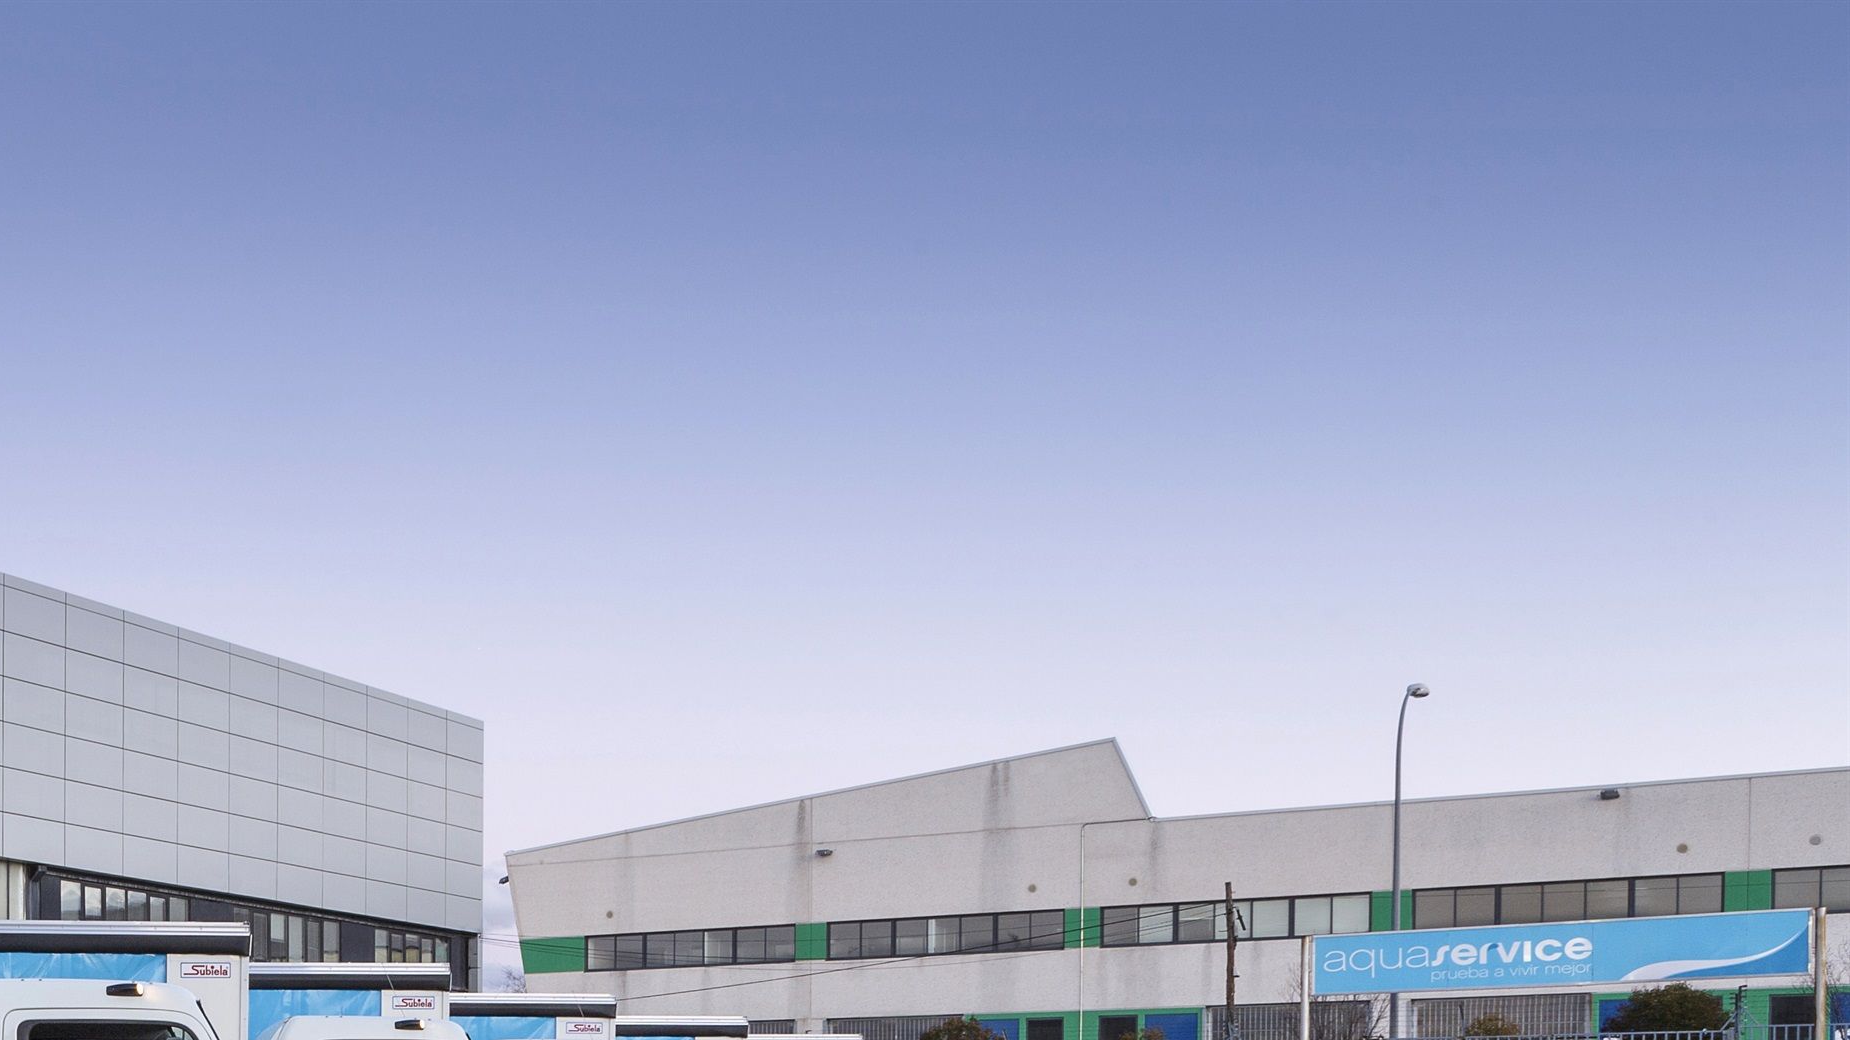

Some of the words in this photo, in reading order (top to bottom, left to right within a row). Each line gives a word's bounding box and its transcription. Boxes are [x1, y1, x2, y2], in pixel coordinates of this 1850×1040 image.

[1323, 936, 1593, 978] aquaservice
[183, 965, 228, 976] Subiela
[1430, 966, 1489, 982] prueba
[1494, 967, 1504, 977] a
[1509, 964, 1539, 976] vivir
[1544, 961, 1592, 977] mejor
[395, 998, 432, 1007] Subiela
